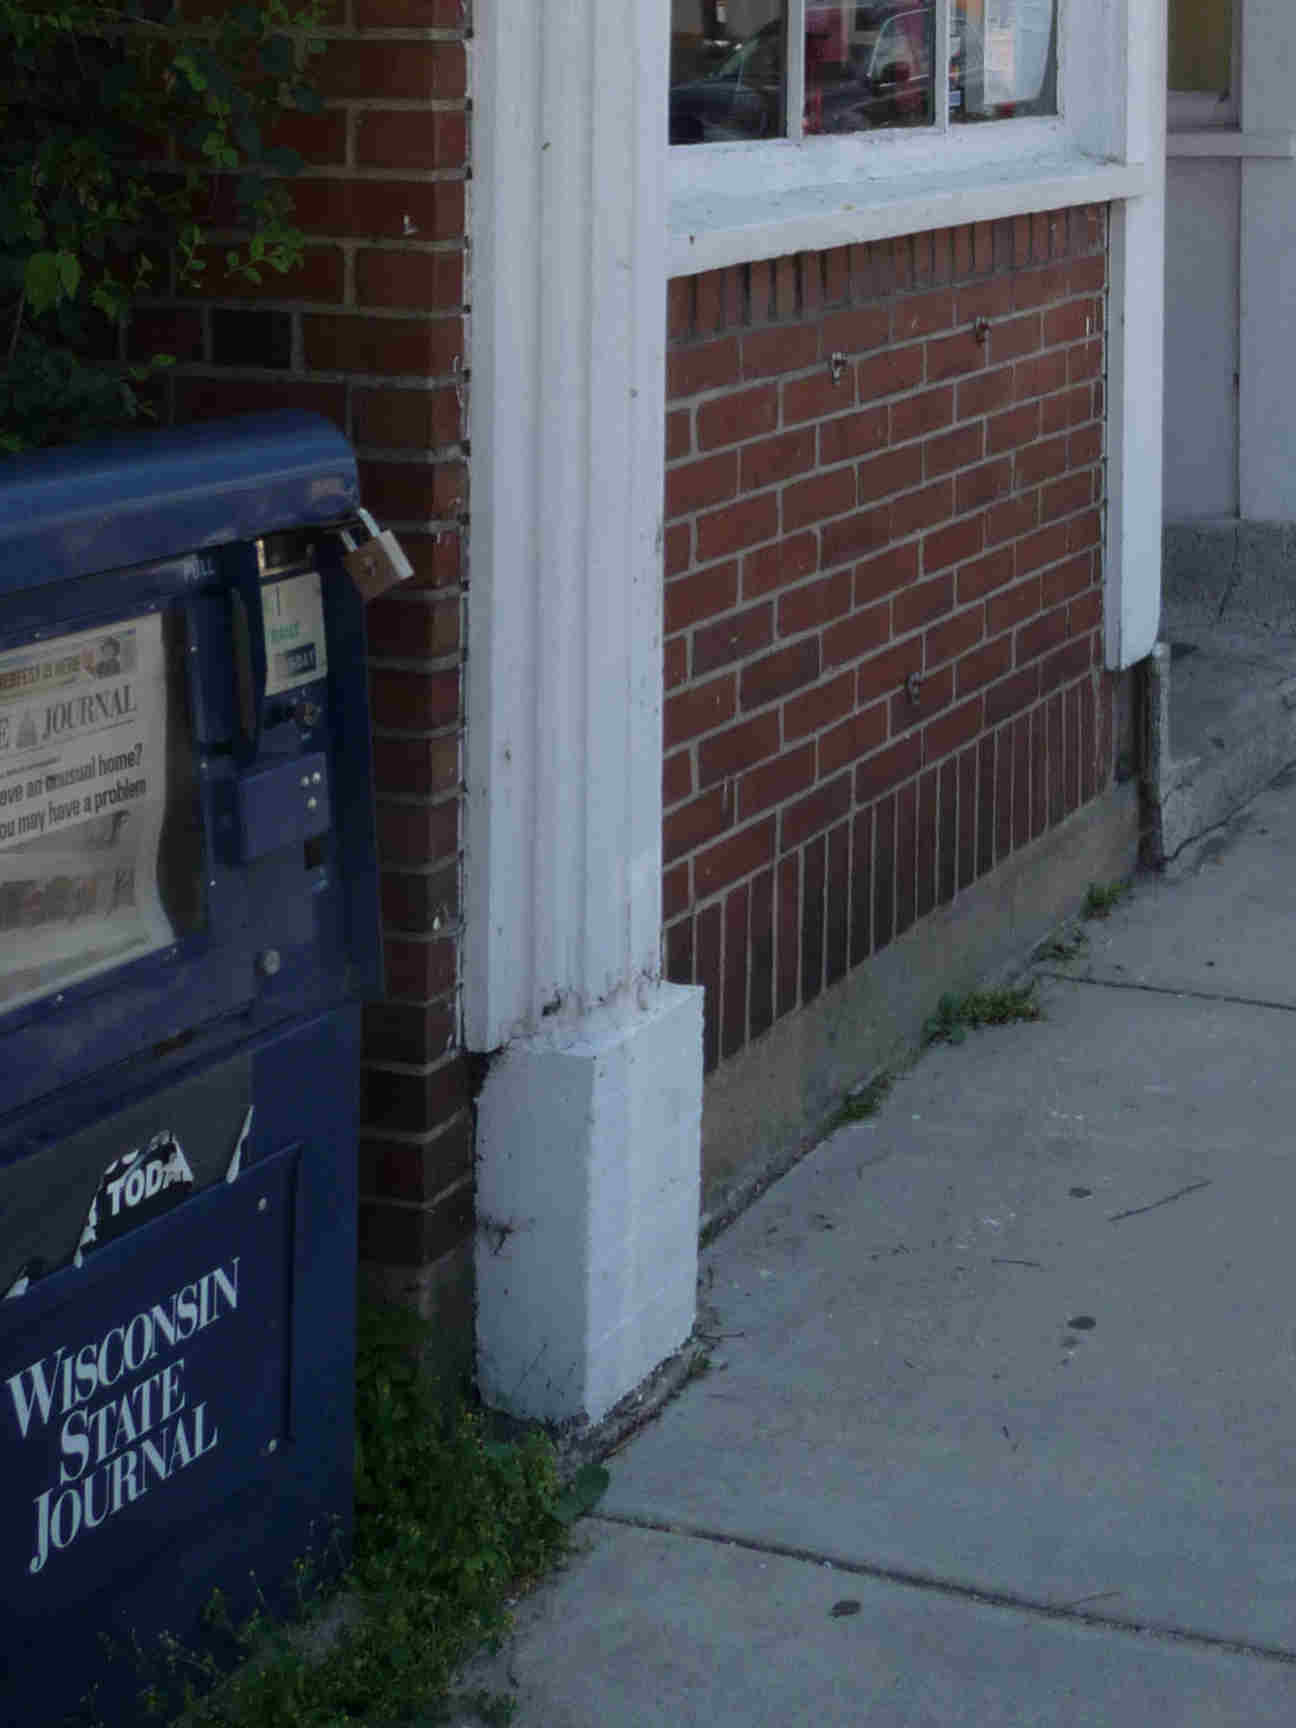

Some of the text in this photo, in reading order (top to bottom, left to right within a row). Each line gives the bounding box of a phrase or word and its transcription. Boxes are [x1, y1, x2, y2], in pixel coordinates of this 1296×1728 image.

[41, 684, 137, 741] JOURNAL
[98, 741, 143, 777] home?
[18, 809, 45, 833] may
[48, 799, 80, 825] have
[94, 777, 147, 814] problem
[4, 1257, 240, 1439] WISCONSIN
[59, 1359, 185, 1484] STATE
[29, 1401, 218, 1573] JOURNAL
